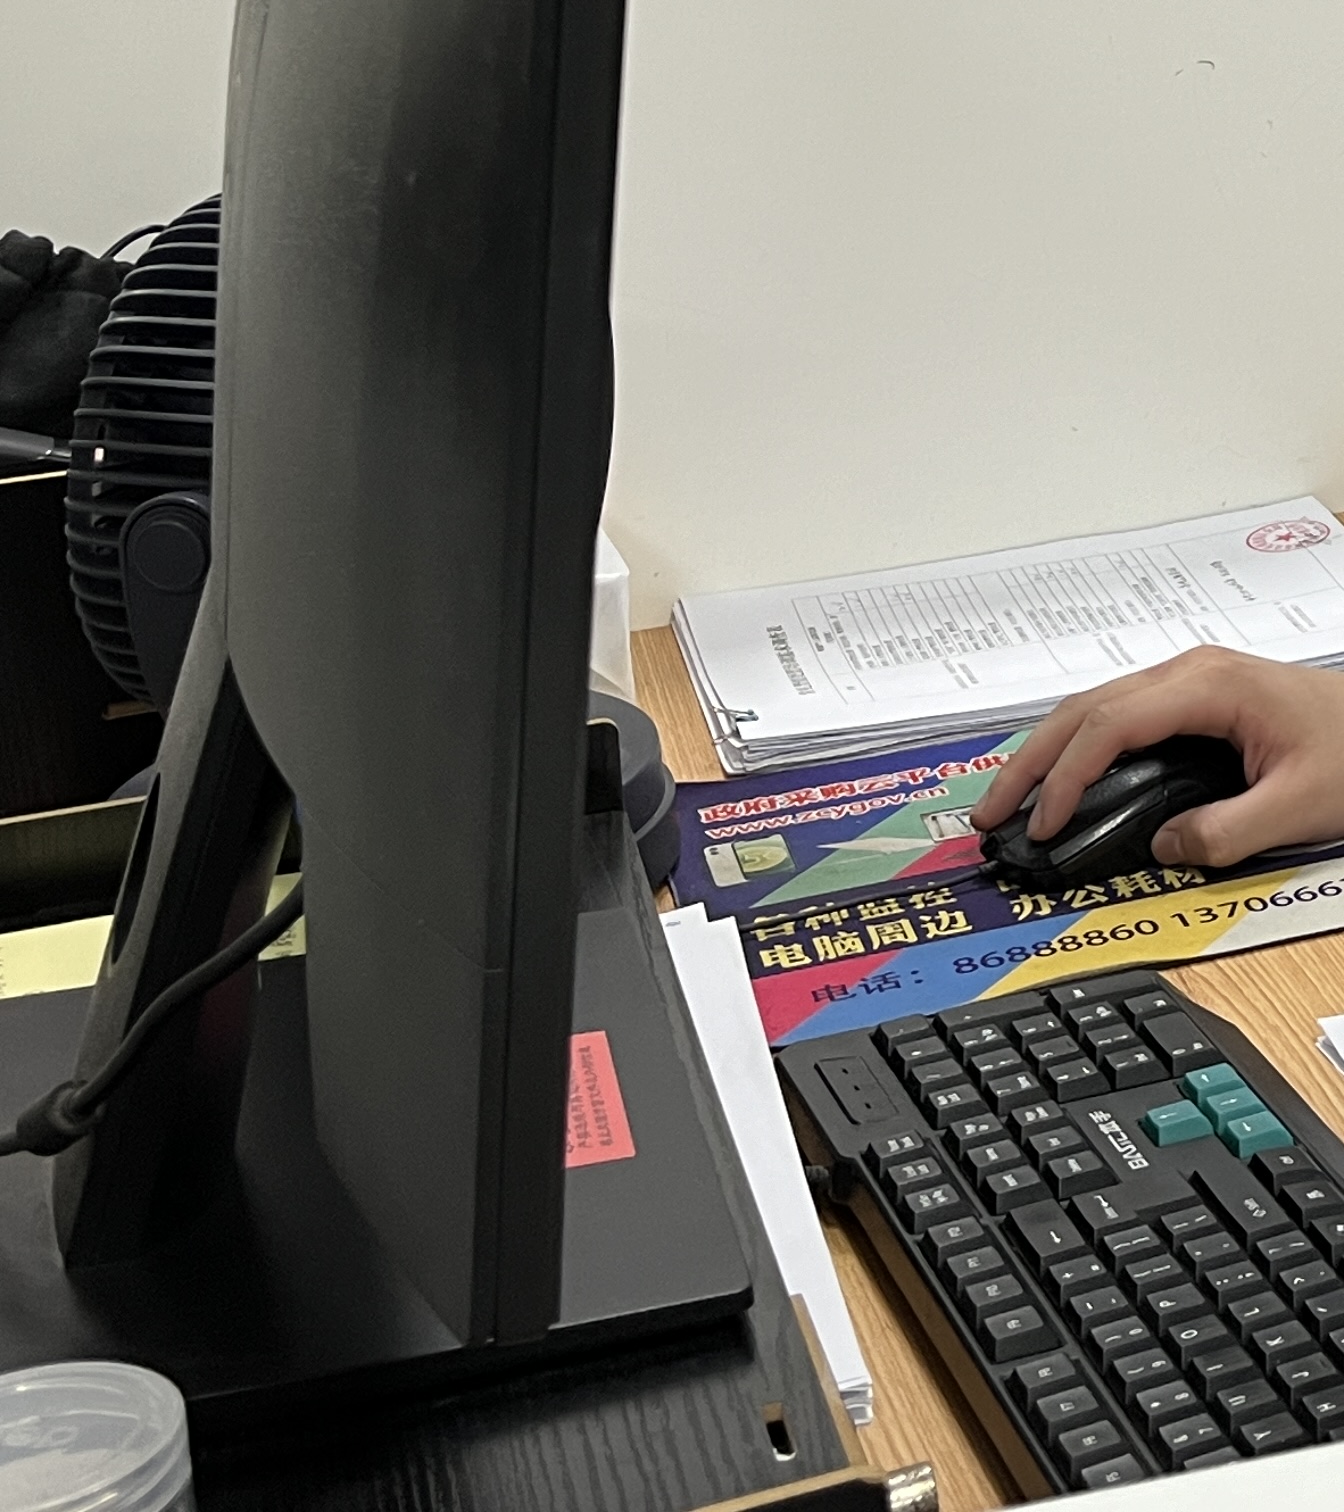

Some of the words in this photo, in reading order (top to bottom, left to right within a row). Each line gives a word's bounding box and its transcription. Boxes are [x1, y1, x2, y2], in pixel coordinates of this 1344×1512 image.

[704, 786, 950, 839] www.zcygov.cn
[758, 910, 973, 969] 电脑周边
[951, 918, 1160, 975] 86888860
